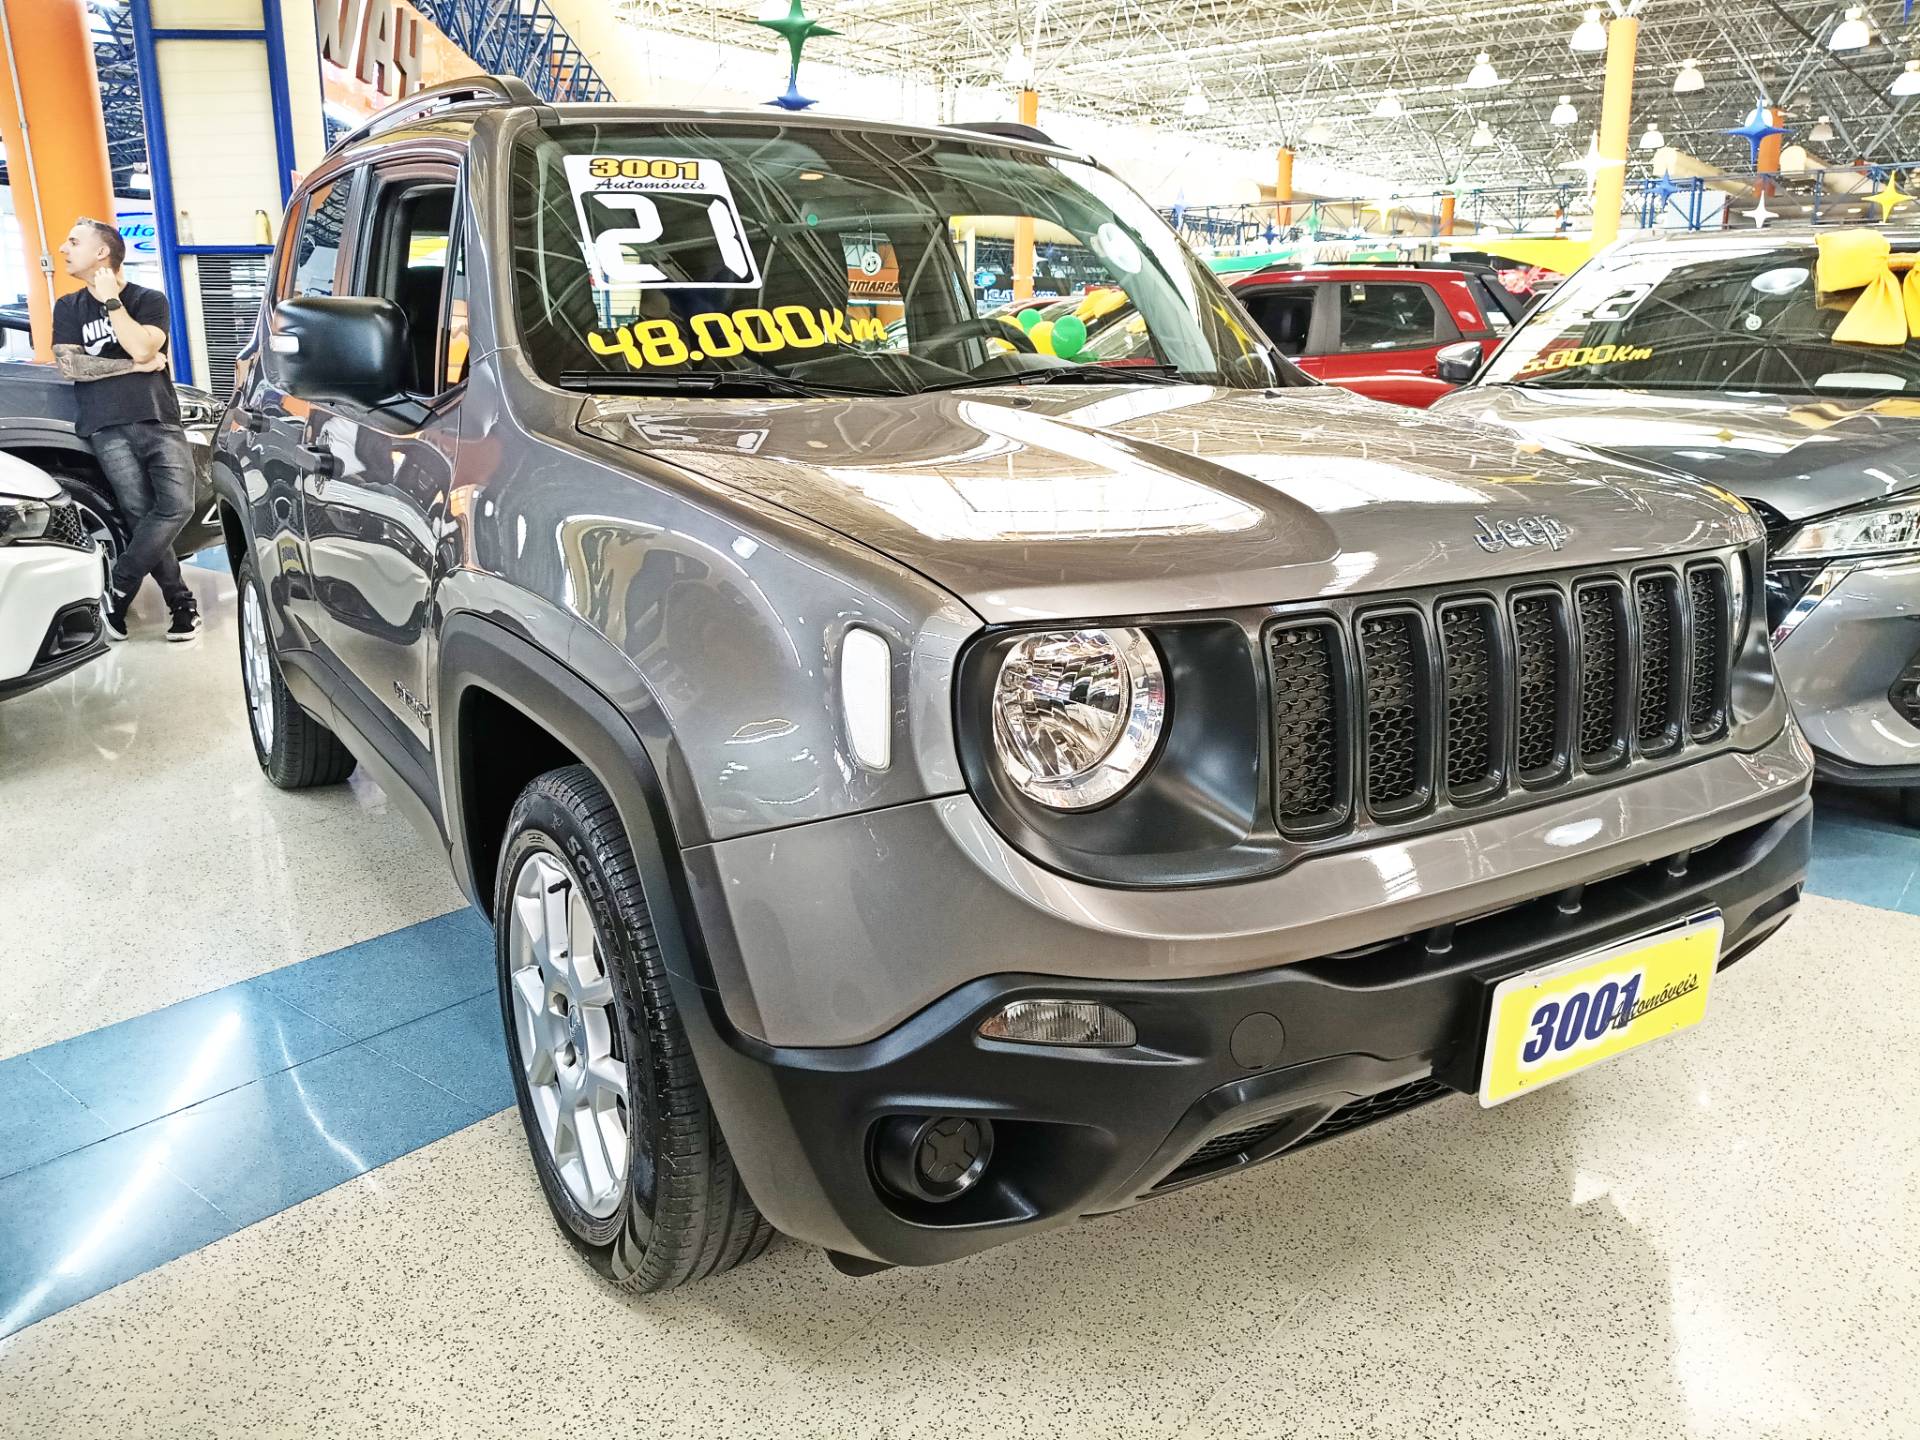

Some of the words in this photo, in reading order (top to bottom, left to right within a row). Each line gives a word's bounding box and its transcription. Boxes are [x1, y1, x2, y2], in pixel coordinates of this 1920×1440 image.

[589, 157, 700, 181] 3001
[594, 177, 708, 191] Automóveis
[118, 224, 156, 237] uto
[593, 193, 749, 282] 21
[587, 305, 888, 369] 48.000Km
[1473, 514, 1574, 553] Jeep
[1522, 973, 1642, 1062] 3001
[1601, 972, 1700, 1030] Automóveis
